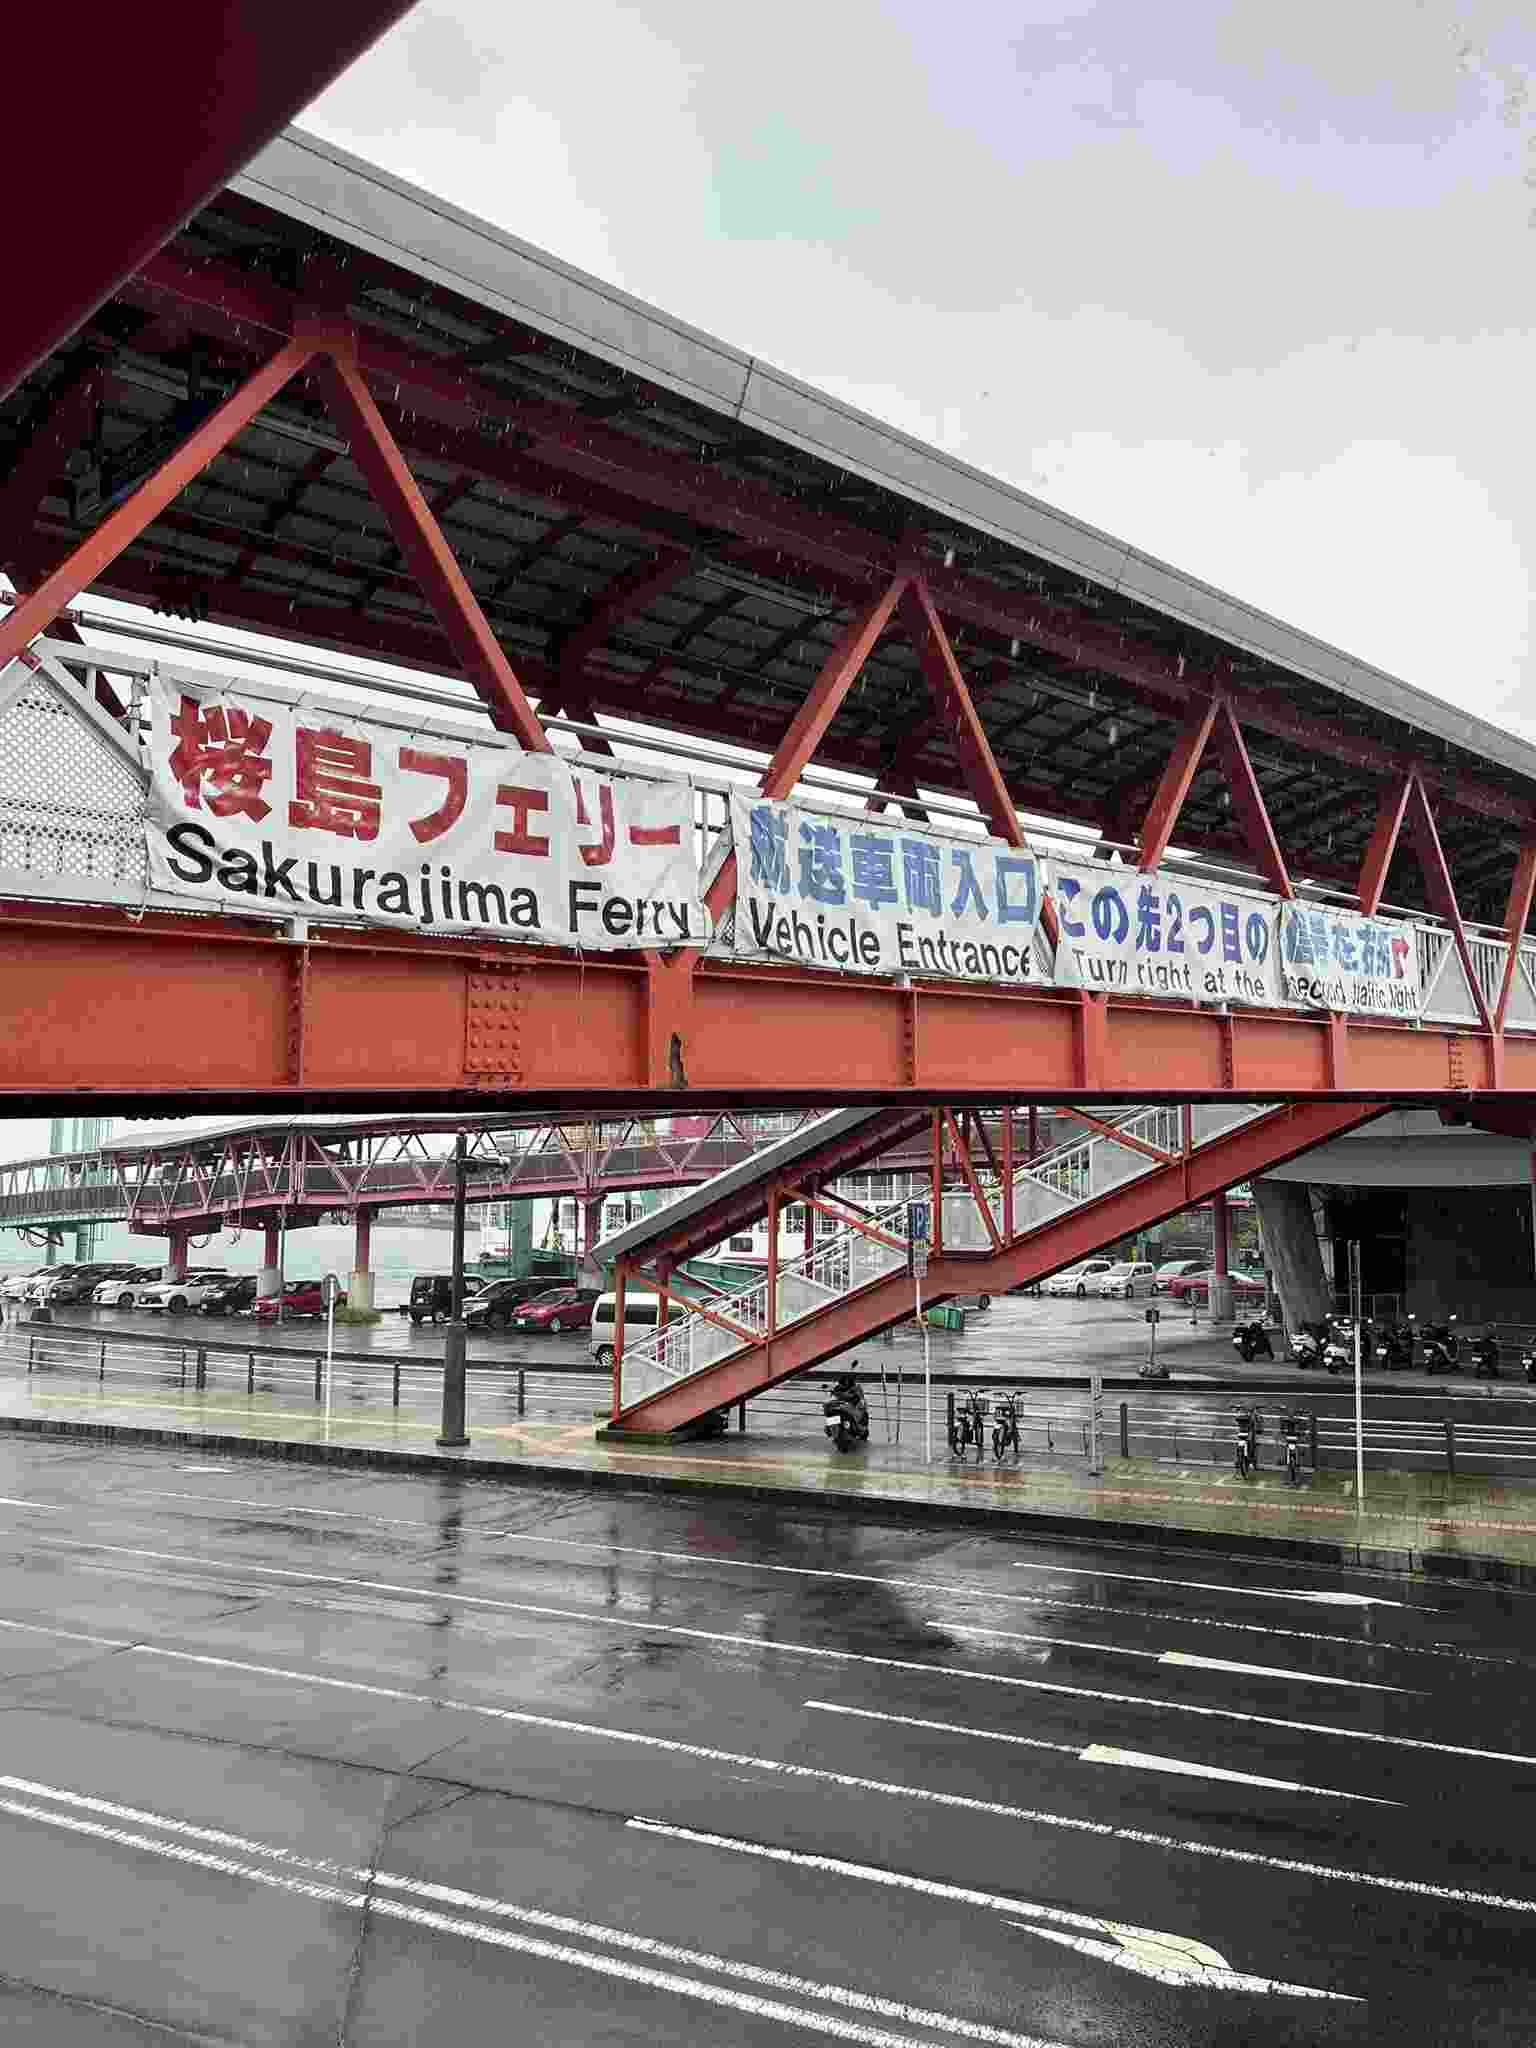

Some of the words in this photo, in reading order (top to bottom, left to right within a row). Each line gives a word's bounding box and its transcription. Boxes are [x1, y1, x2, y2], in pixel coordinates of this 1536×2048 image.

[168, 694, 681, 866] 桜島フェリー
[166, 822, 541, 930] Sakurajima
[568, 879, 691, 939] Ferry
[750, 899, 881, 966] Vehicle
[896, 921, 1031, 977] Entrance
[1072, 949, 1128, 984] Turn
[1137, 957, 1192, 991] right
[1204, 967, 1227, 994] at
[1235, 968, 1265, 997] the
